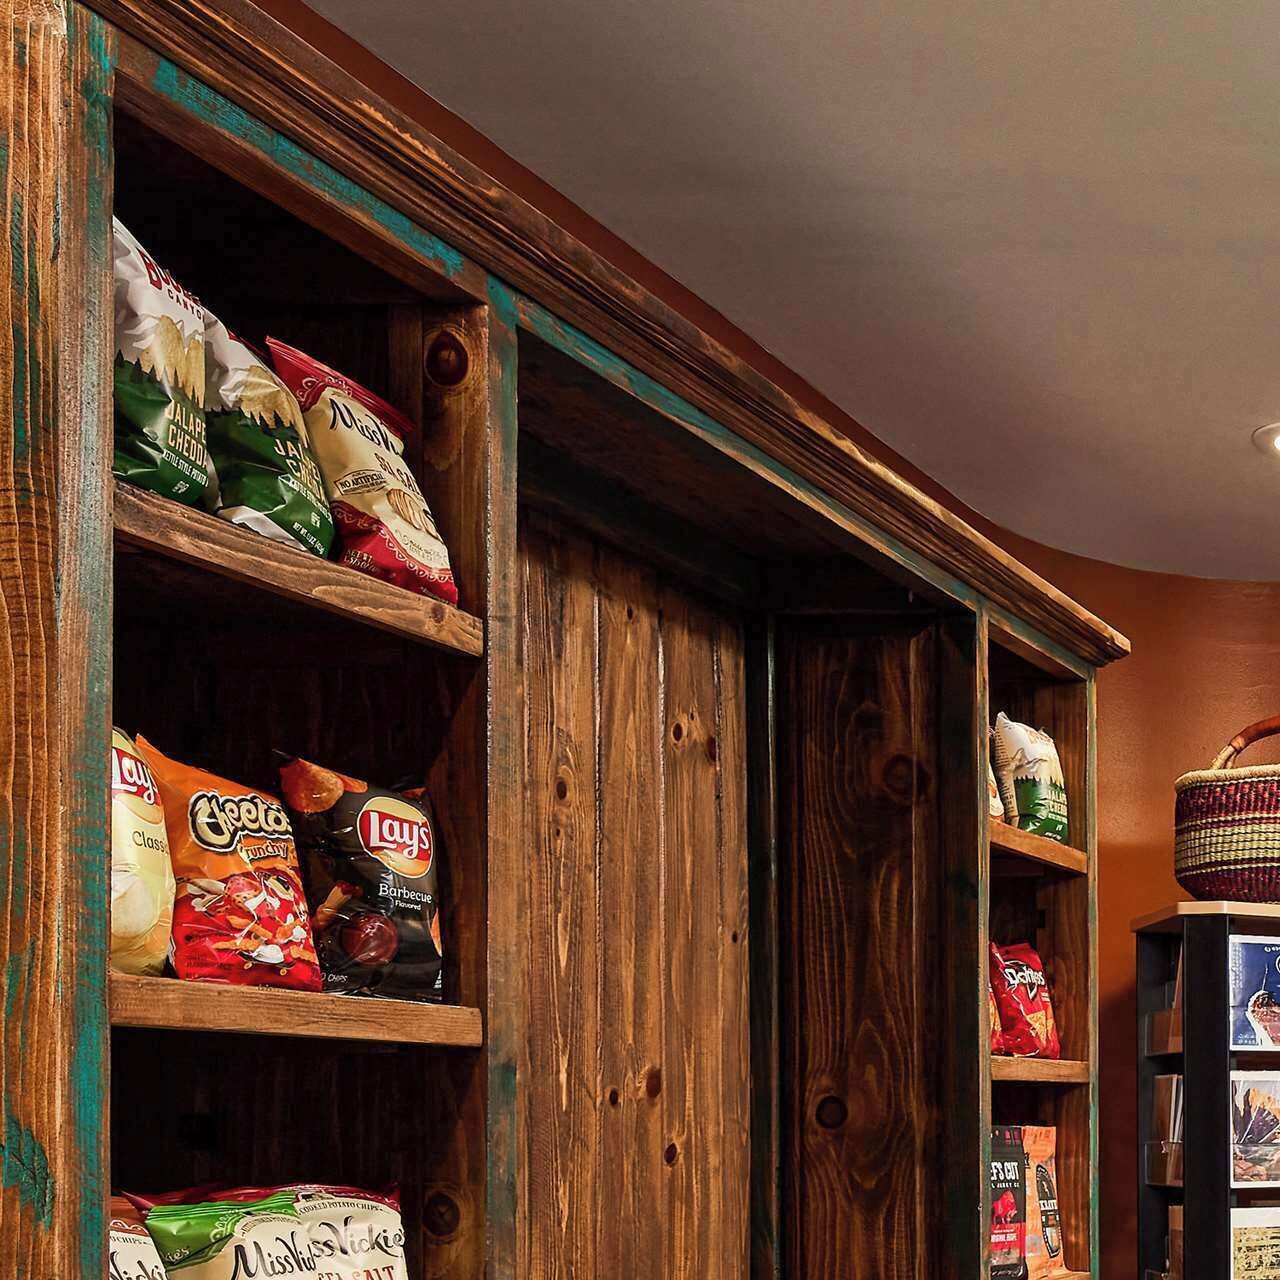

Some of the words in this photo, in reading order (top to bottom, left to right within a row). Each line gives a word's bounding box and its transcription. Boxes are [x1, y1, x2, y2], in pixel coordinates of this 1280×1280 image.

[340, 477, 351, 490] NO
[190, 792, 291, 850] Cheeto
[368, 811, 431, 859] Lay's
[379, 883, 432, 904] Barbecue
[395, 900, 422, 911] Flavored
[329, 1200, 356, 1210] POTATO
[356, 1202, 379, 1212] CHIPS
